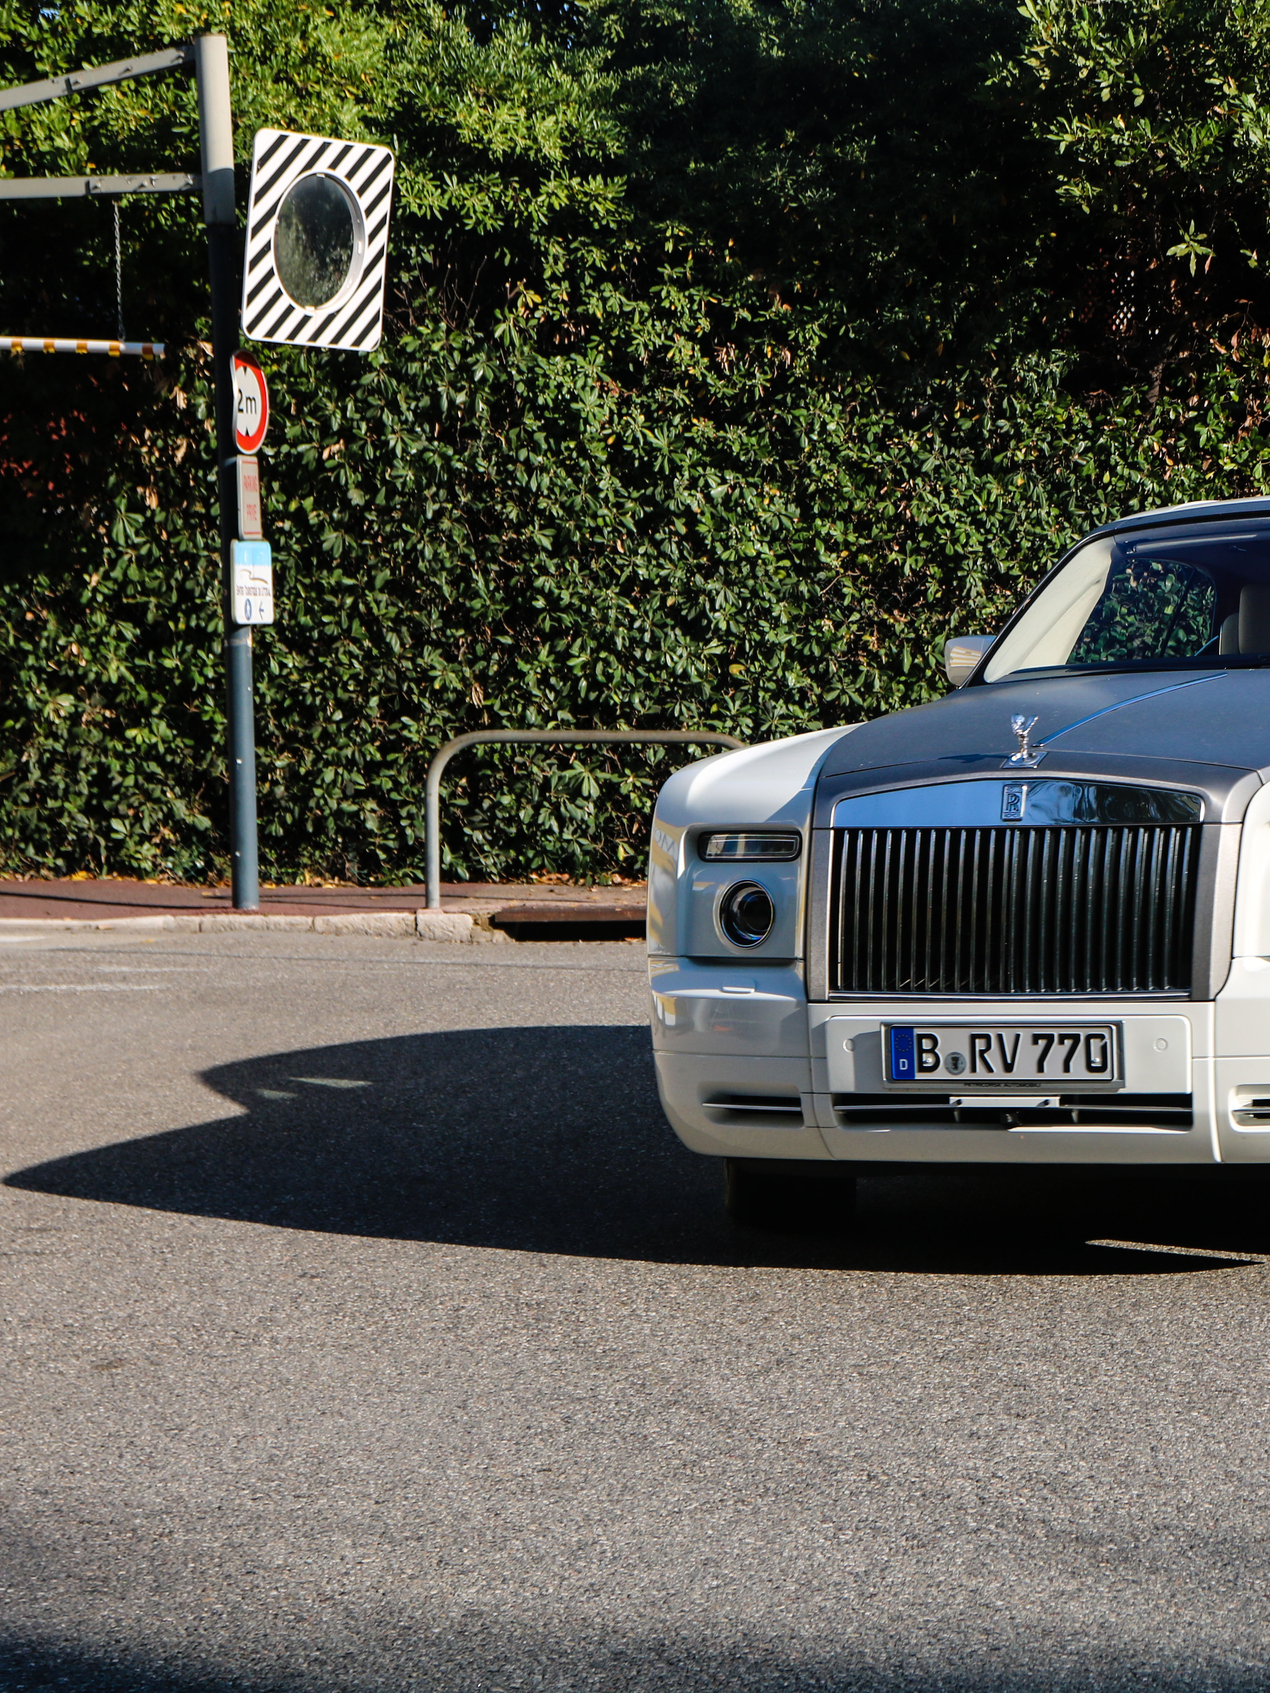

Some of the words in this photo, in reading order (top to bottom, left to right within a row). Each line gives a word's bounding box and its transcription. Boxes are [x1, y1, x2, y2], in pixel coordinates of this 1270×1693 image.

[899, 1058, 908, 1070] D
[916, 1033, 941, 1073] B
[970, 1033, 1021, 1073] RV
[1032, 1033, 1108, 1073] 770
